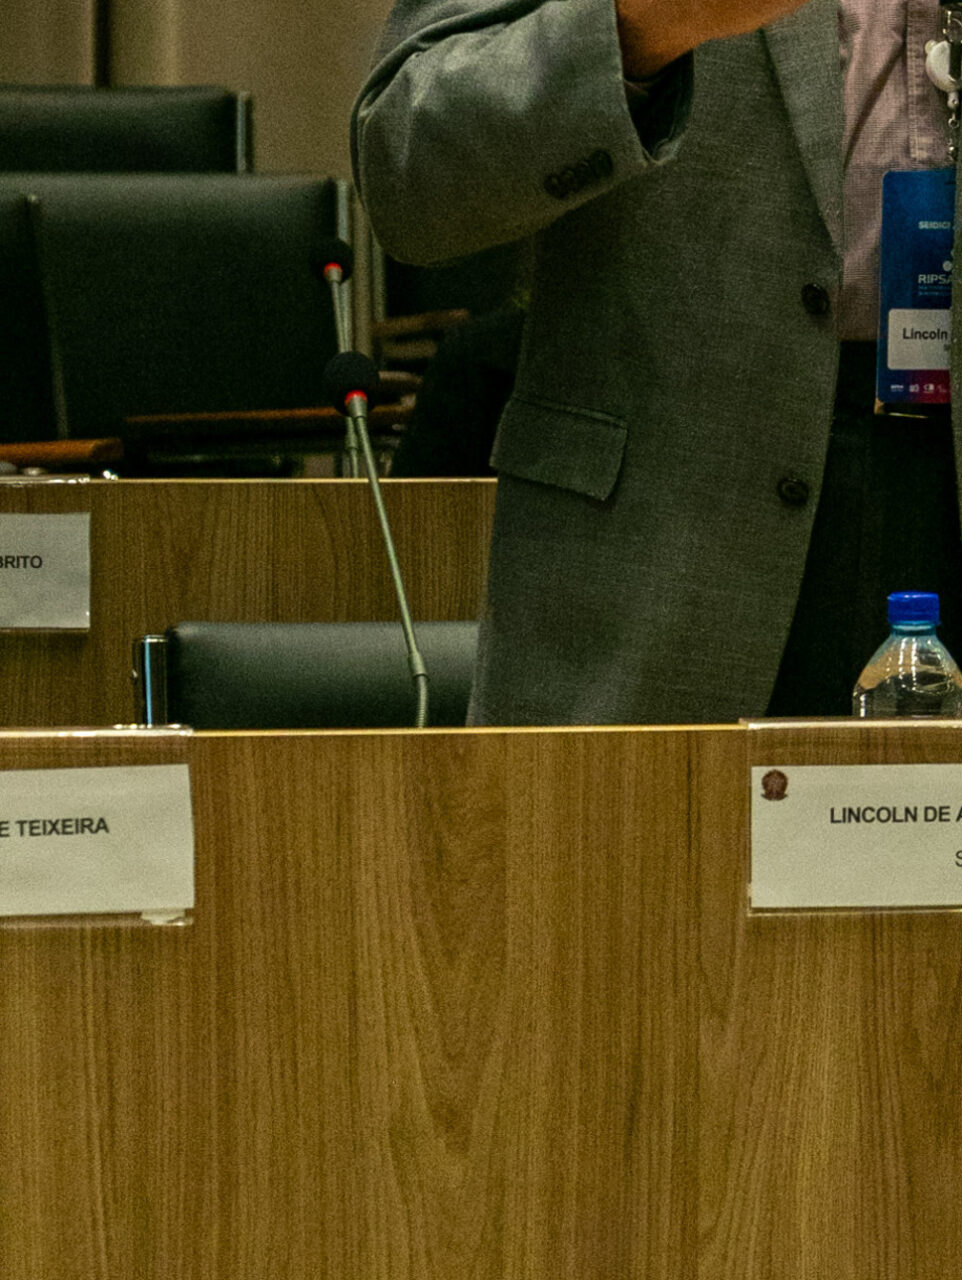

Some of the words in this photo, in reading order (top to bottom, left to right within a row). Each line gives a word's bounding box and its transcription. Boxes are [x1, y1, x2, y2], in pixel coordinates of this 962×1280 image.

[902, 328, 948, 341] Lincoln
[830, 806, 918, 824] LINCOLN
[923, 805, 951, 823] DE
[15, 817, 110, 837] TEIXEIRA
